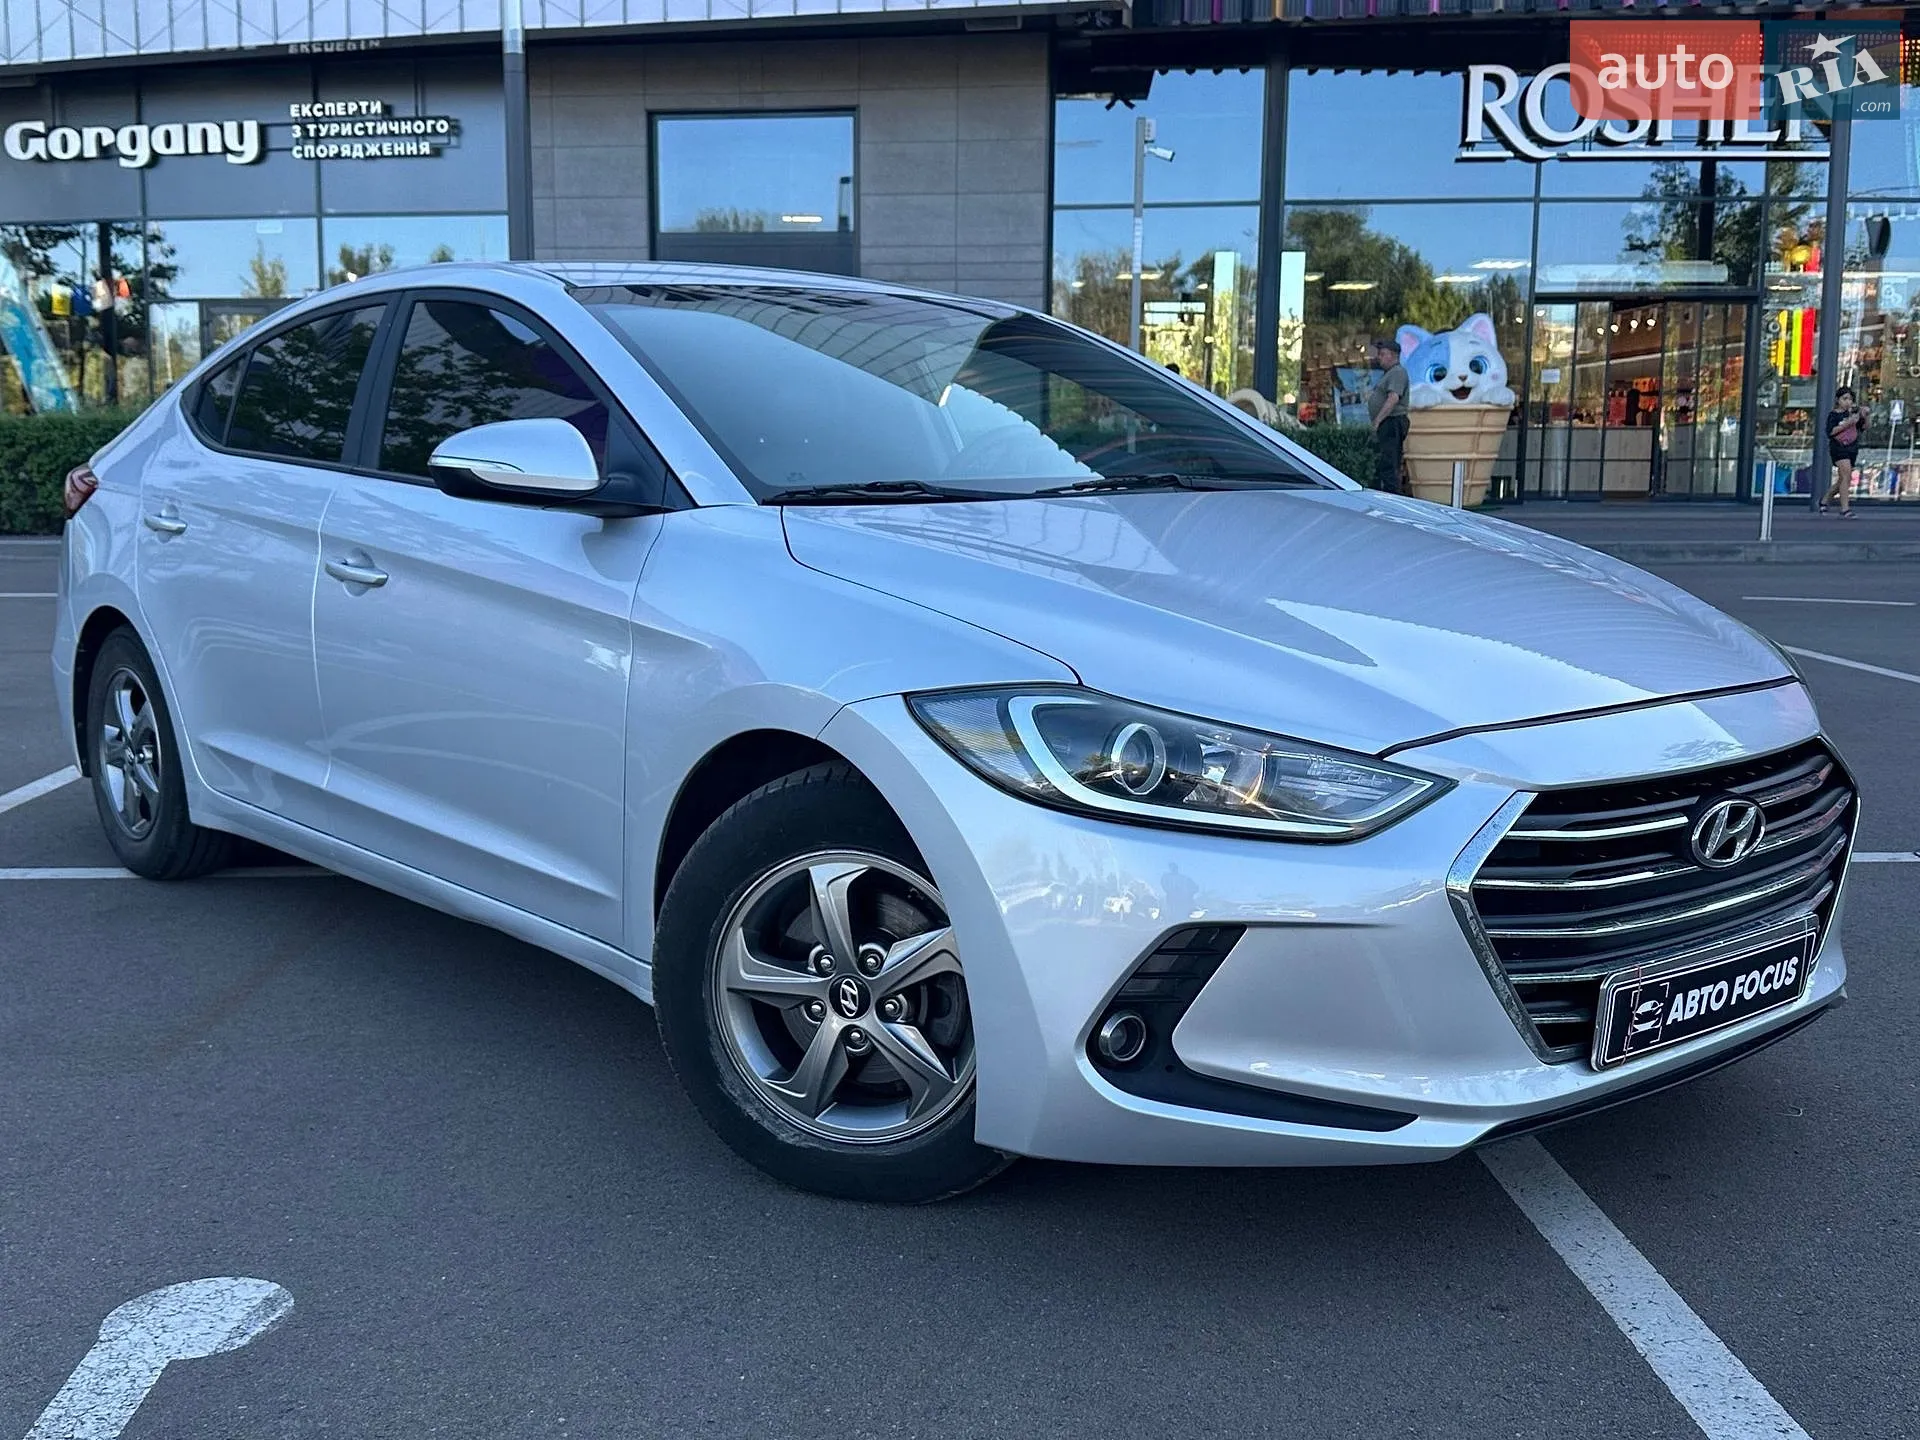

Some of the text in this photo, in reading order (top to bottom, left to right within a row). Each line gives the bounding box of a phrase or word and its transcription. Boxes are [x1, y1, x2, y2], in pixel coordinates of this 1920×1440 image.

[289, 100, 382, 118] ЕКСПЕРТИ
[306, 119, 450, 138] ТУРИСТИЧНОГО
[3, 120, 259, 168] Gorgany
[291, 141, 431, 159] СПОРЯДЖЕННЯ
[1731, 956, 1798, 1005] FOCUS
